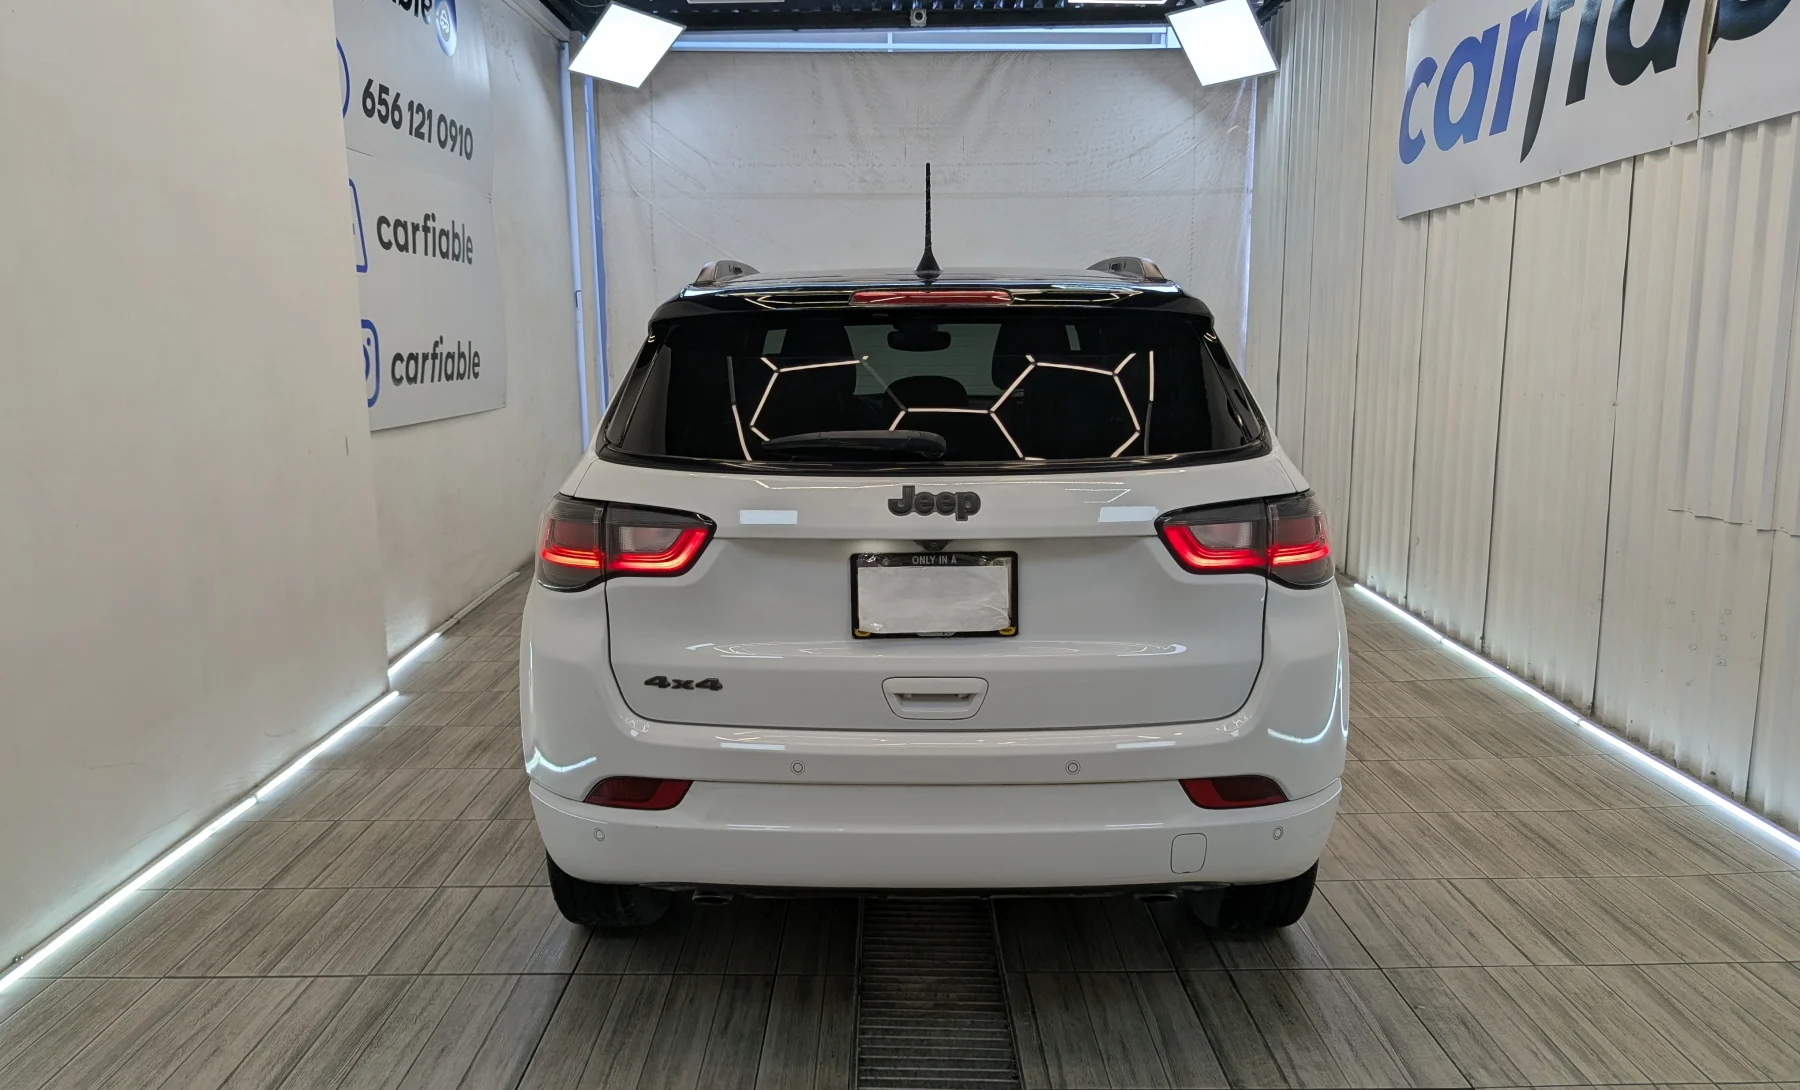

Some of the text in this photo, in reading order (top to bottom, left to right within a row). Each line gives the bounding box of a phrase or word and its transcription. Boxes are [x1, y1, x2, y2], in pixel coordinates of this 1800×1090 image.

[362, 77, 474, 161] 656 121 0910
[376, 212, 474, 265] carfiable
[391, 335, 481, 387] carfiable
[887, 485, 982, 521] Jeep
[912, 555, 957, 565] ONLY IN A
[644, 675, 723, 691] 4x4
